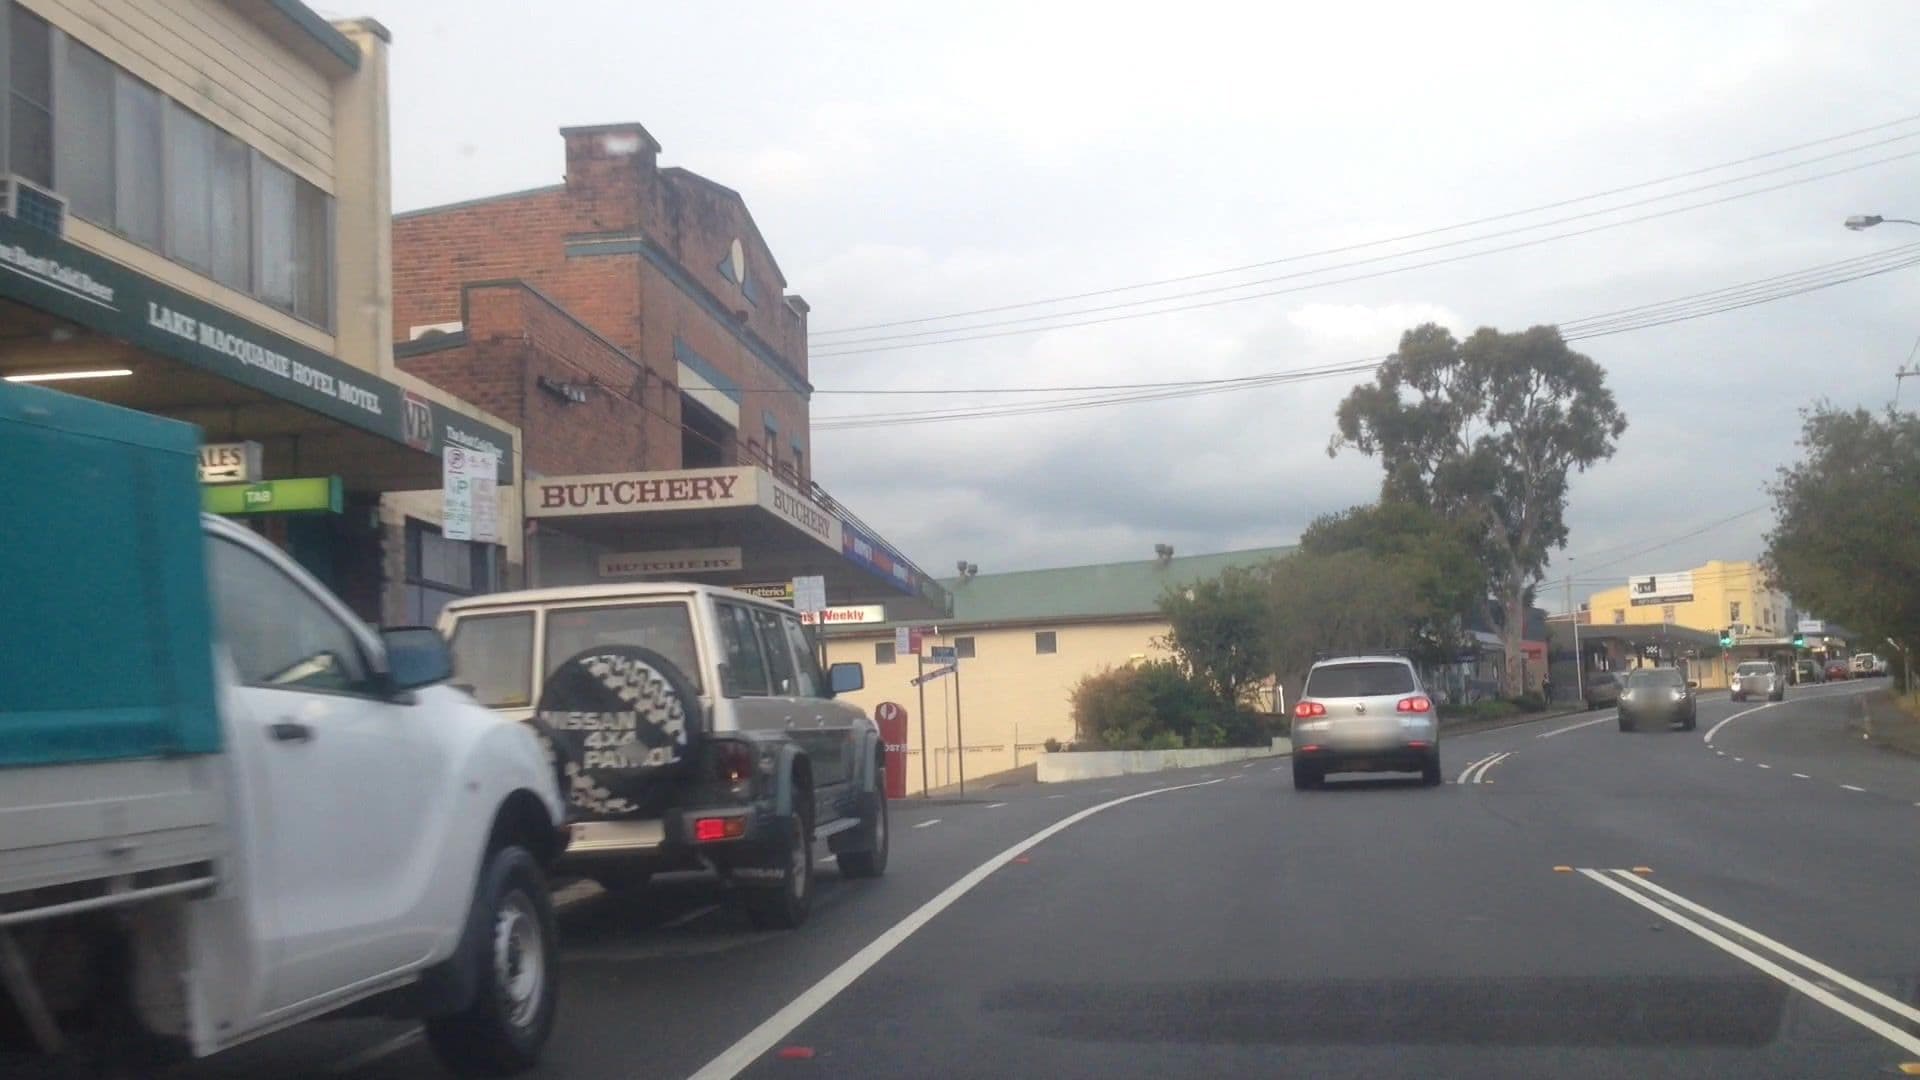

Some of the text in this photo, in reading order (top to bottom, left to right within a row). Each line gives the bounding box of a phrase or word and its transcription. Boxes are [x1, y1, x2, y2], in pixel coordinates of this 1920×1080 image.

[149, 301, 383, 416] LAKE MACQUARIE HOTEL MOTEL
[403, 400, 432, 441] VB
[245, 490, 272, 503] TAB
[540, 475, 738, 509] BUTCHERY
[772, 485, 831, 540] BUTCHERY
[606, 558, 735, 573] BUTCHERY
[822, 609, 865, 622] Weekly
[539, 710, 638, 731] NISSAN
[583, 745, 682, 769] PAOL
[884, 743, 902, 752] OST
